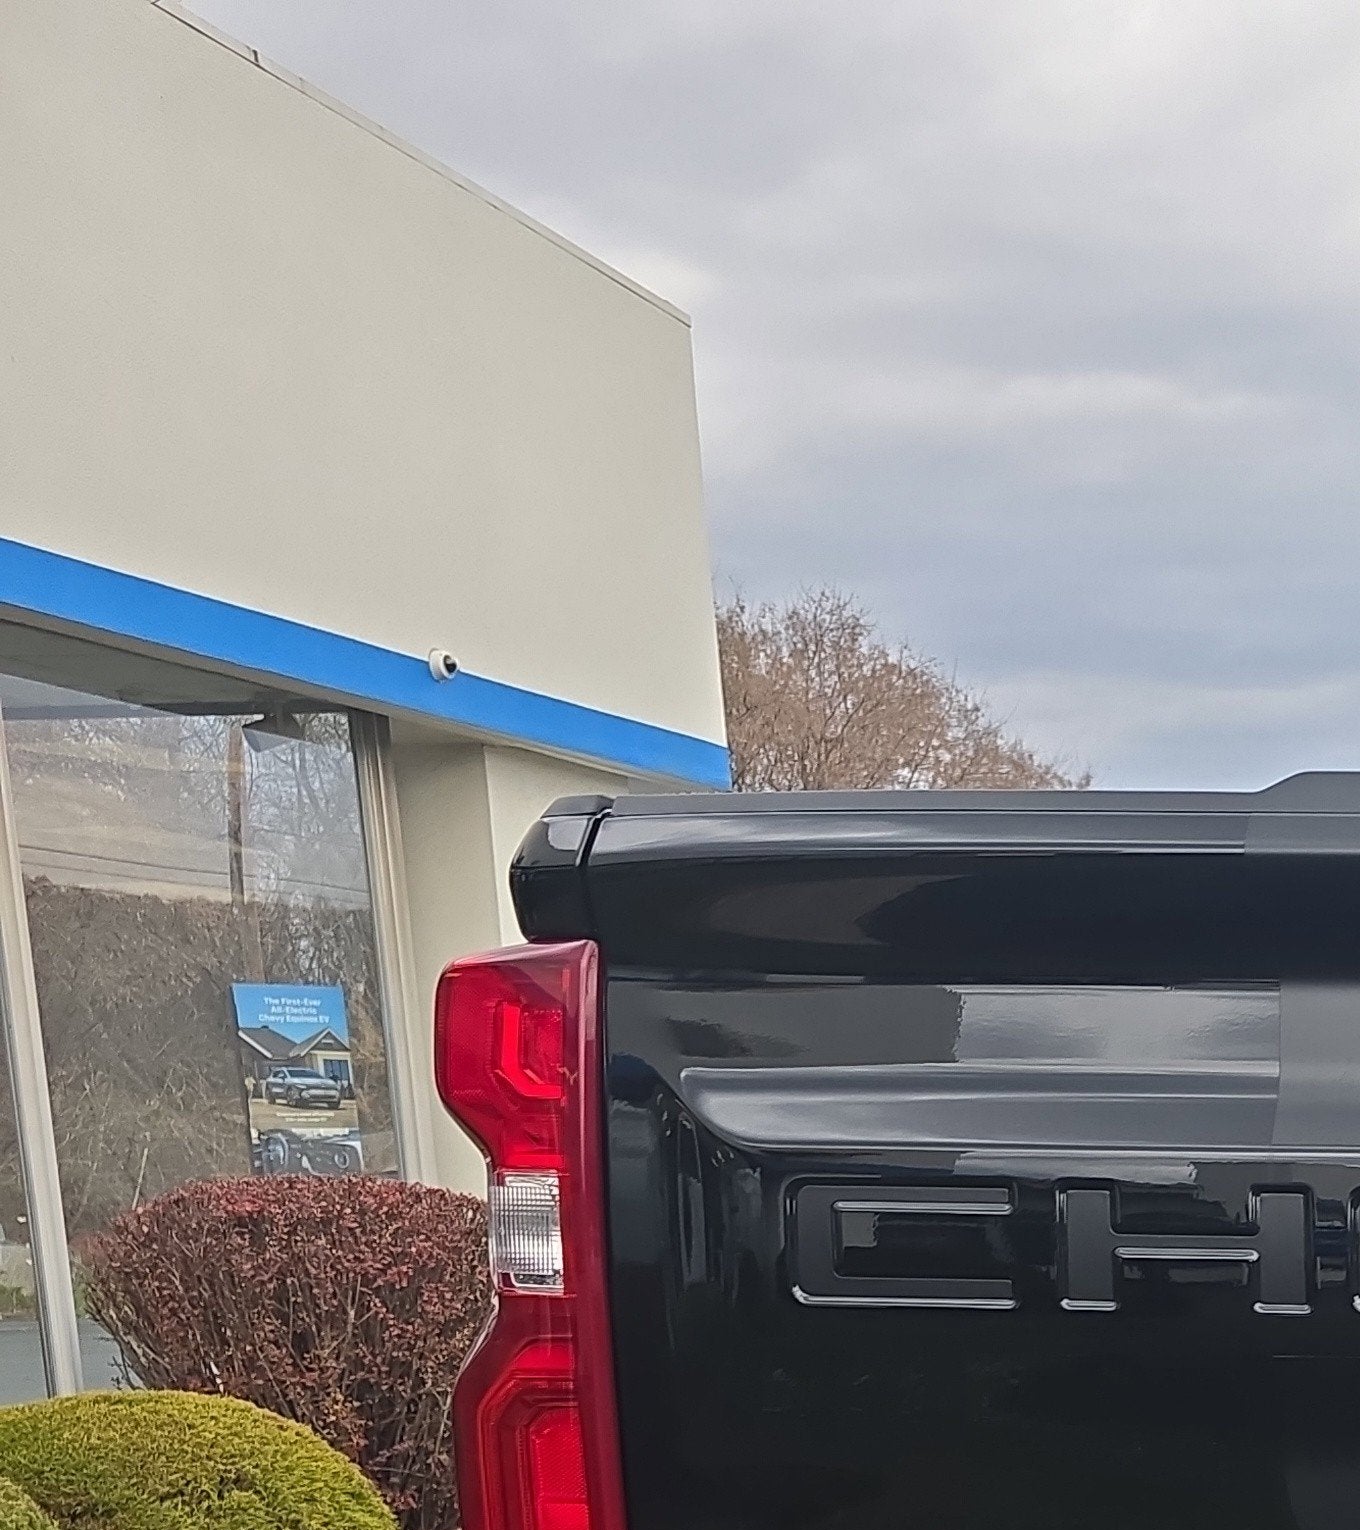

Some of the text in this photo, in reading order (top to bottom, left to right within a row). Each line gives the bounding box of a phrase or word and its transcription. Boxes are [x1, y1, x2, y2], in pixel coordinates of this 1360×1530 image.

[263, 997, 321, 1006] The First-Ever
[258, 1014, 285, 1024] Chevy
[319, 1016, 330, 1024] EV
